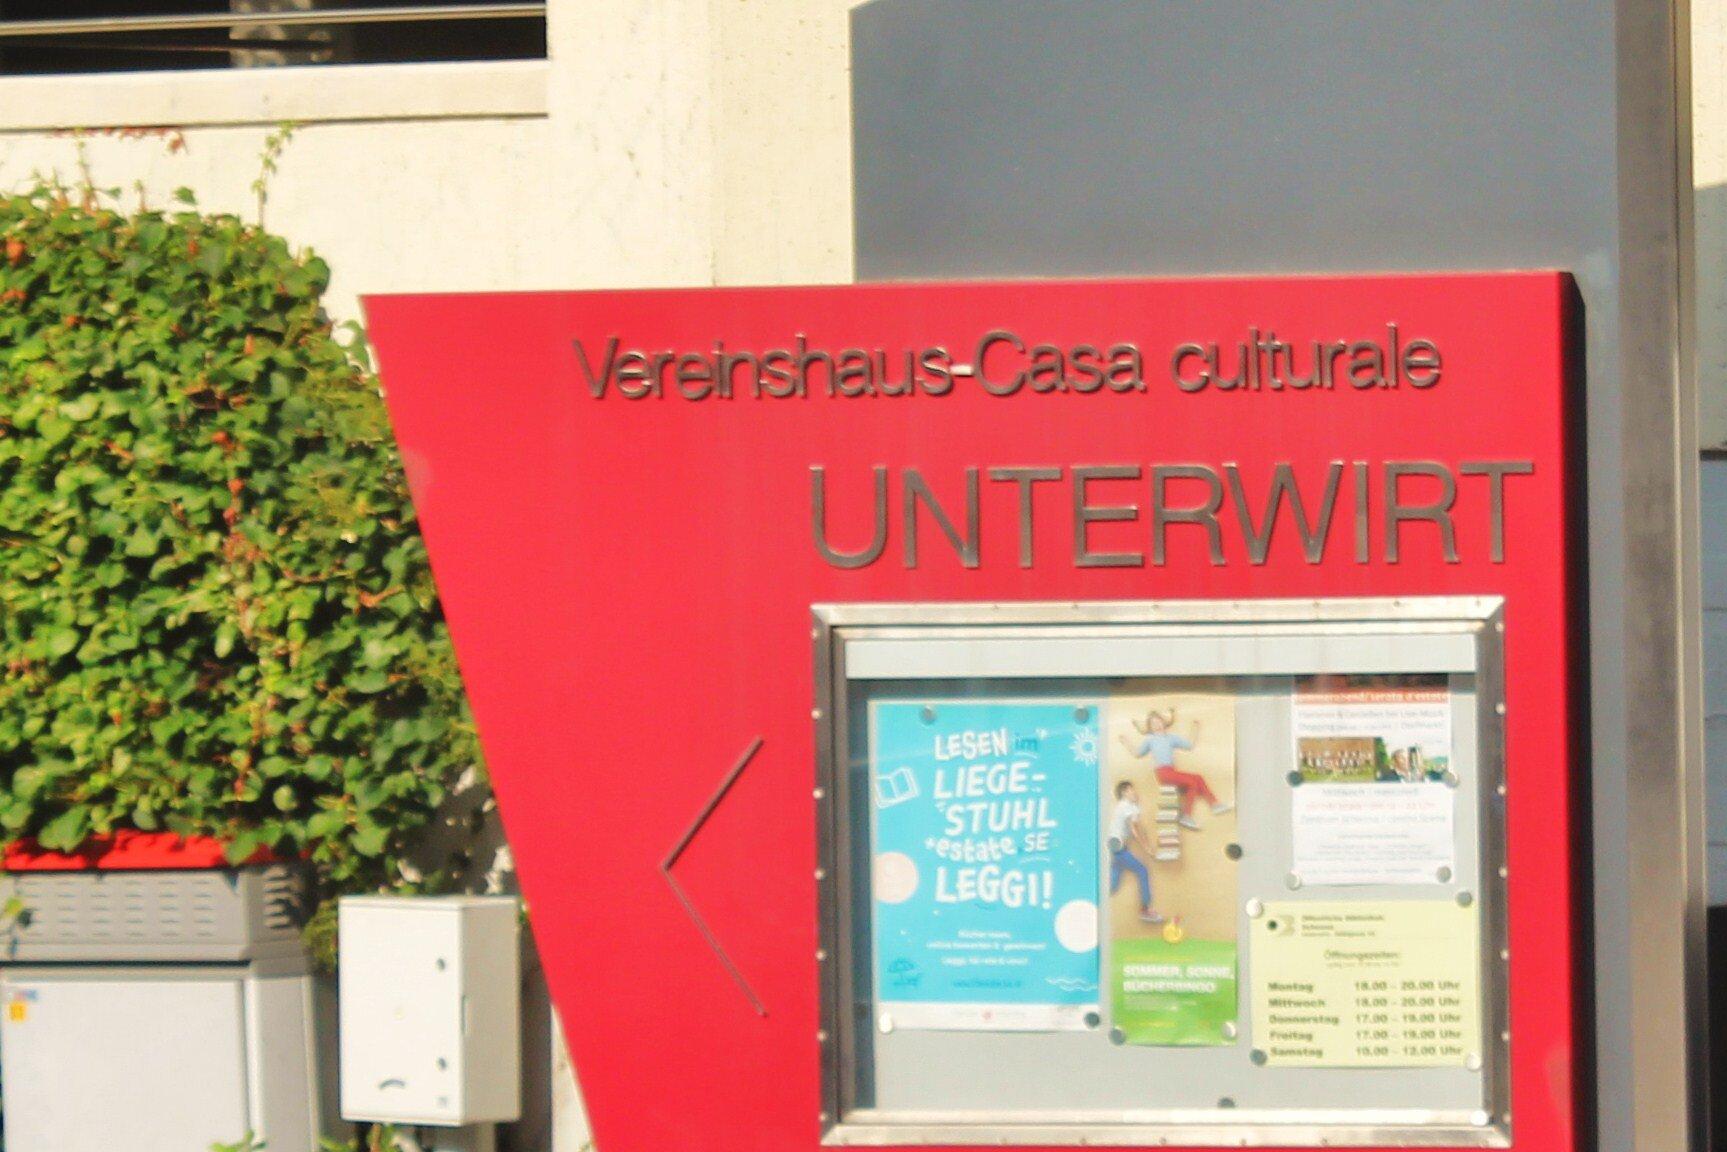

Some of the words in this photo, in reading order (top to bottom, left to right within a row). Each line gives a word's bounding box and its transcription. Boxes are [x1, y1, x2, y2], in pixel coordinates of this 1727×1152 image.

[572, 327, 1144, 399] Vereinshaus-Casa
[1170, 320, 1441, 391] culturale
[808, 460, 1534, 570] UNTERWIRT
[933, 728, 1008, 761] LESEN
[932, 760, 1046, 799] LIEGE-
[944, 797, 1058, 837] STUHL
[936, 835, 1017, 864] estate
[1024, 832, 1050, 852] SE
[934, 864, 1054, 909] LEGGI!
[1266, 982, 1315, 994] Montag
[1267, 998, 1327, 1008] Mittwoch
[1268, 1014, 1341, 1026] Donnerstag
[1269, 1030, 1314, 1043] Freitag
[1270, 1047, 1324, 1059] Samstag
